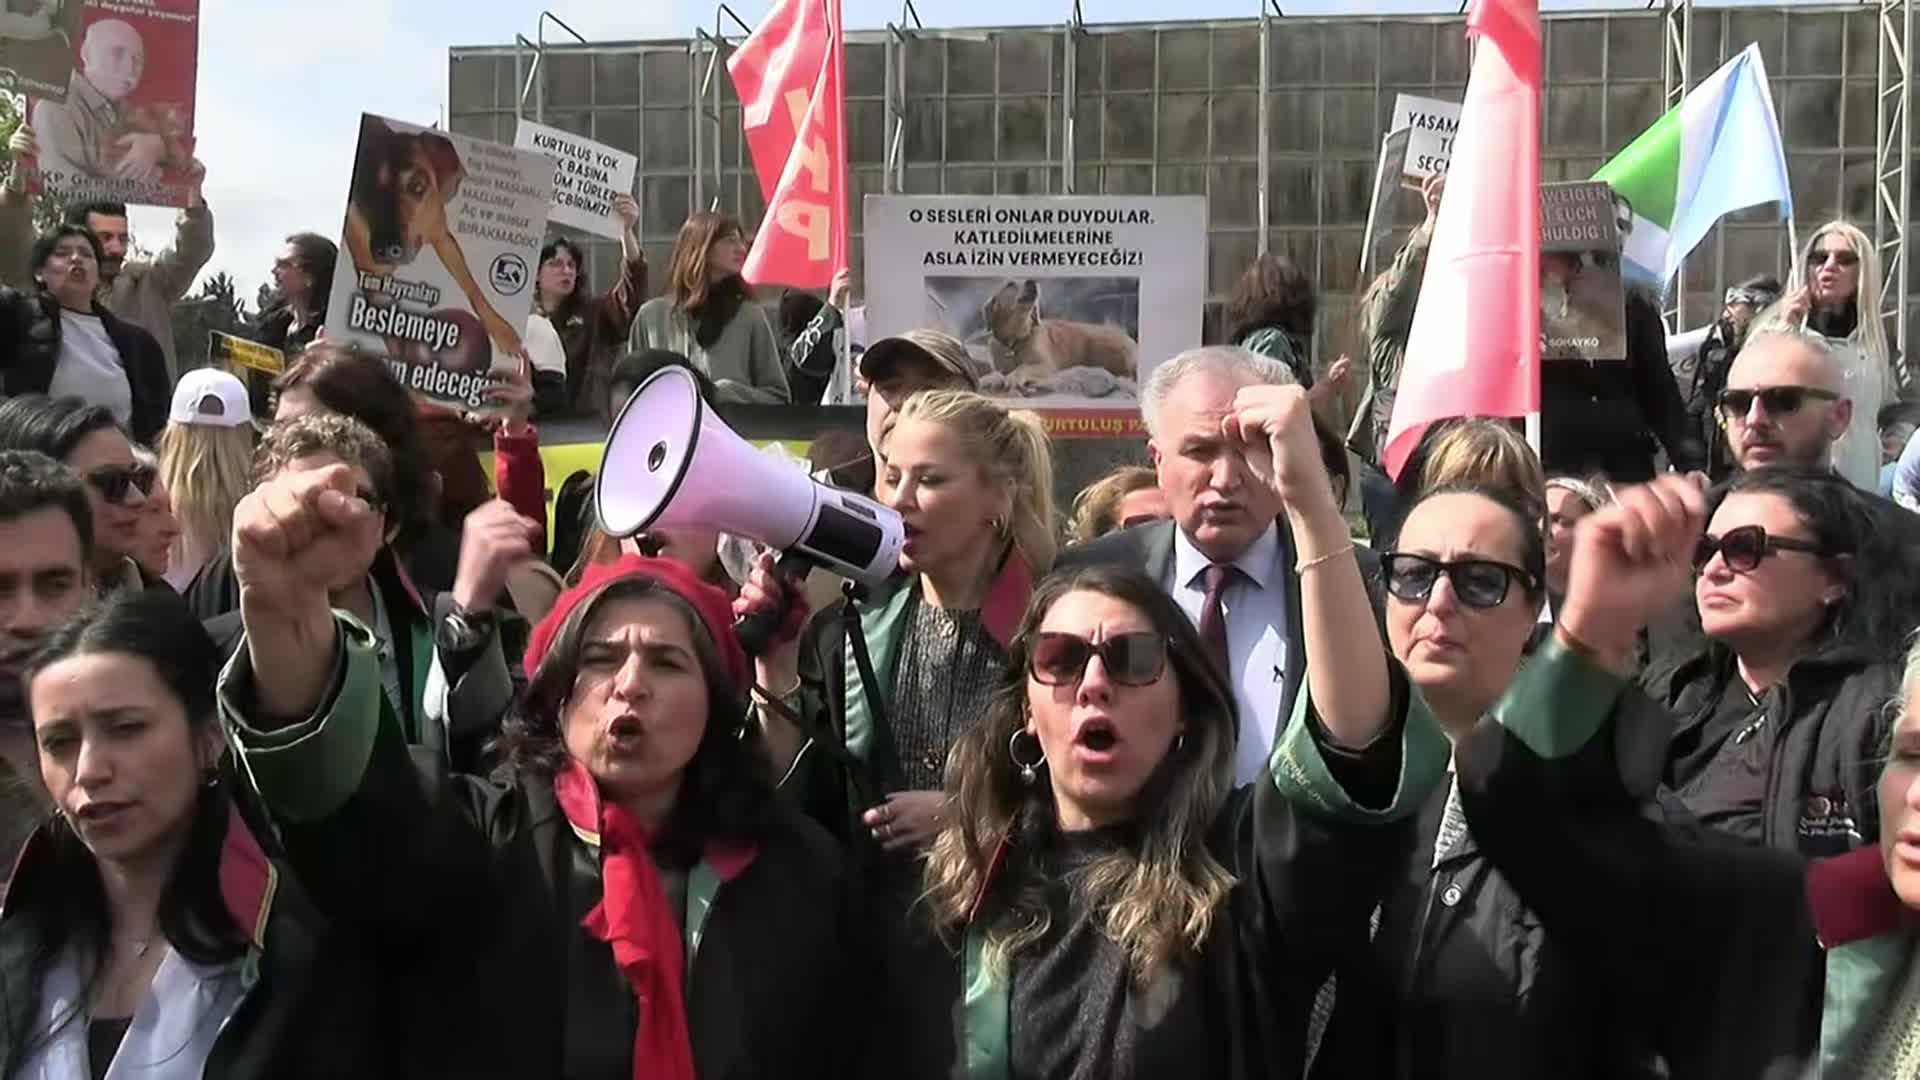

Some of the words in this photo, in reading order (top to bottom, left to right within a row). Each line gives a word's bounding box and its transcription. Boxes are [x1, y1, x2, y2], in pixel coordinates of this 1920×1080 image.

[596, 152, 619, 169] YOK
[553, 172, 573, 188] ÜM
[1543, 187, 1608, 202] WEIGEN
[909, 209, 923, 224] O
[927, 208, 991, 224] SESLERİ
[995, 209, 1053, 224] ONLAR
[954, 229, 1113, 245] KATLEDİLMELERİNE
[1542, 224, 1600, 240] HULDIG
[923, 251, 967, 265] ASLA
[971, 249, 1004, 265] İZİN
[1008, 249, 1144, 265] VERMEYECEĞİZ!
[351, 297, 459, 350] Beslemeye
[1044, 417, 1123, 435] URTULUŞ
